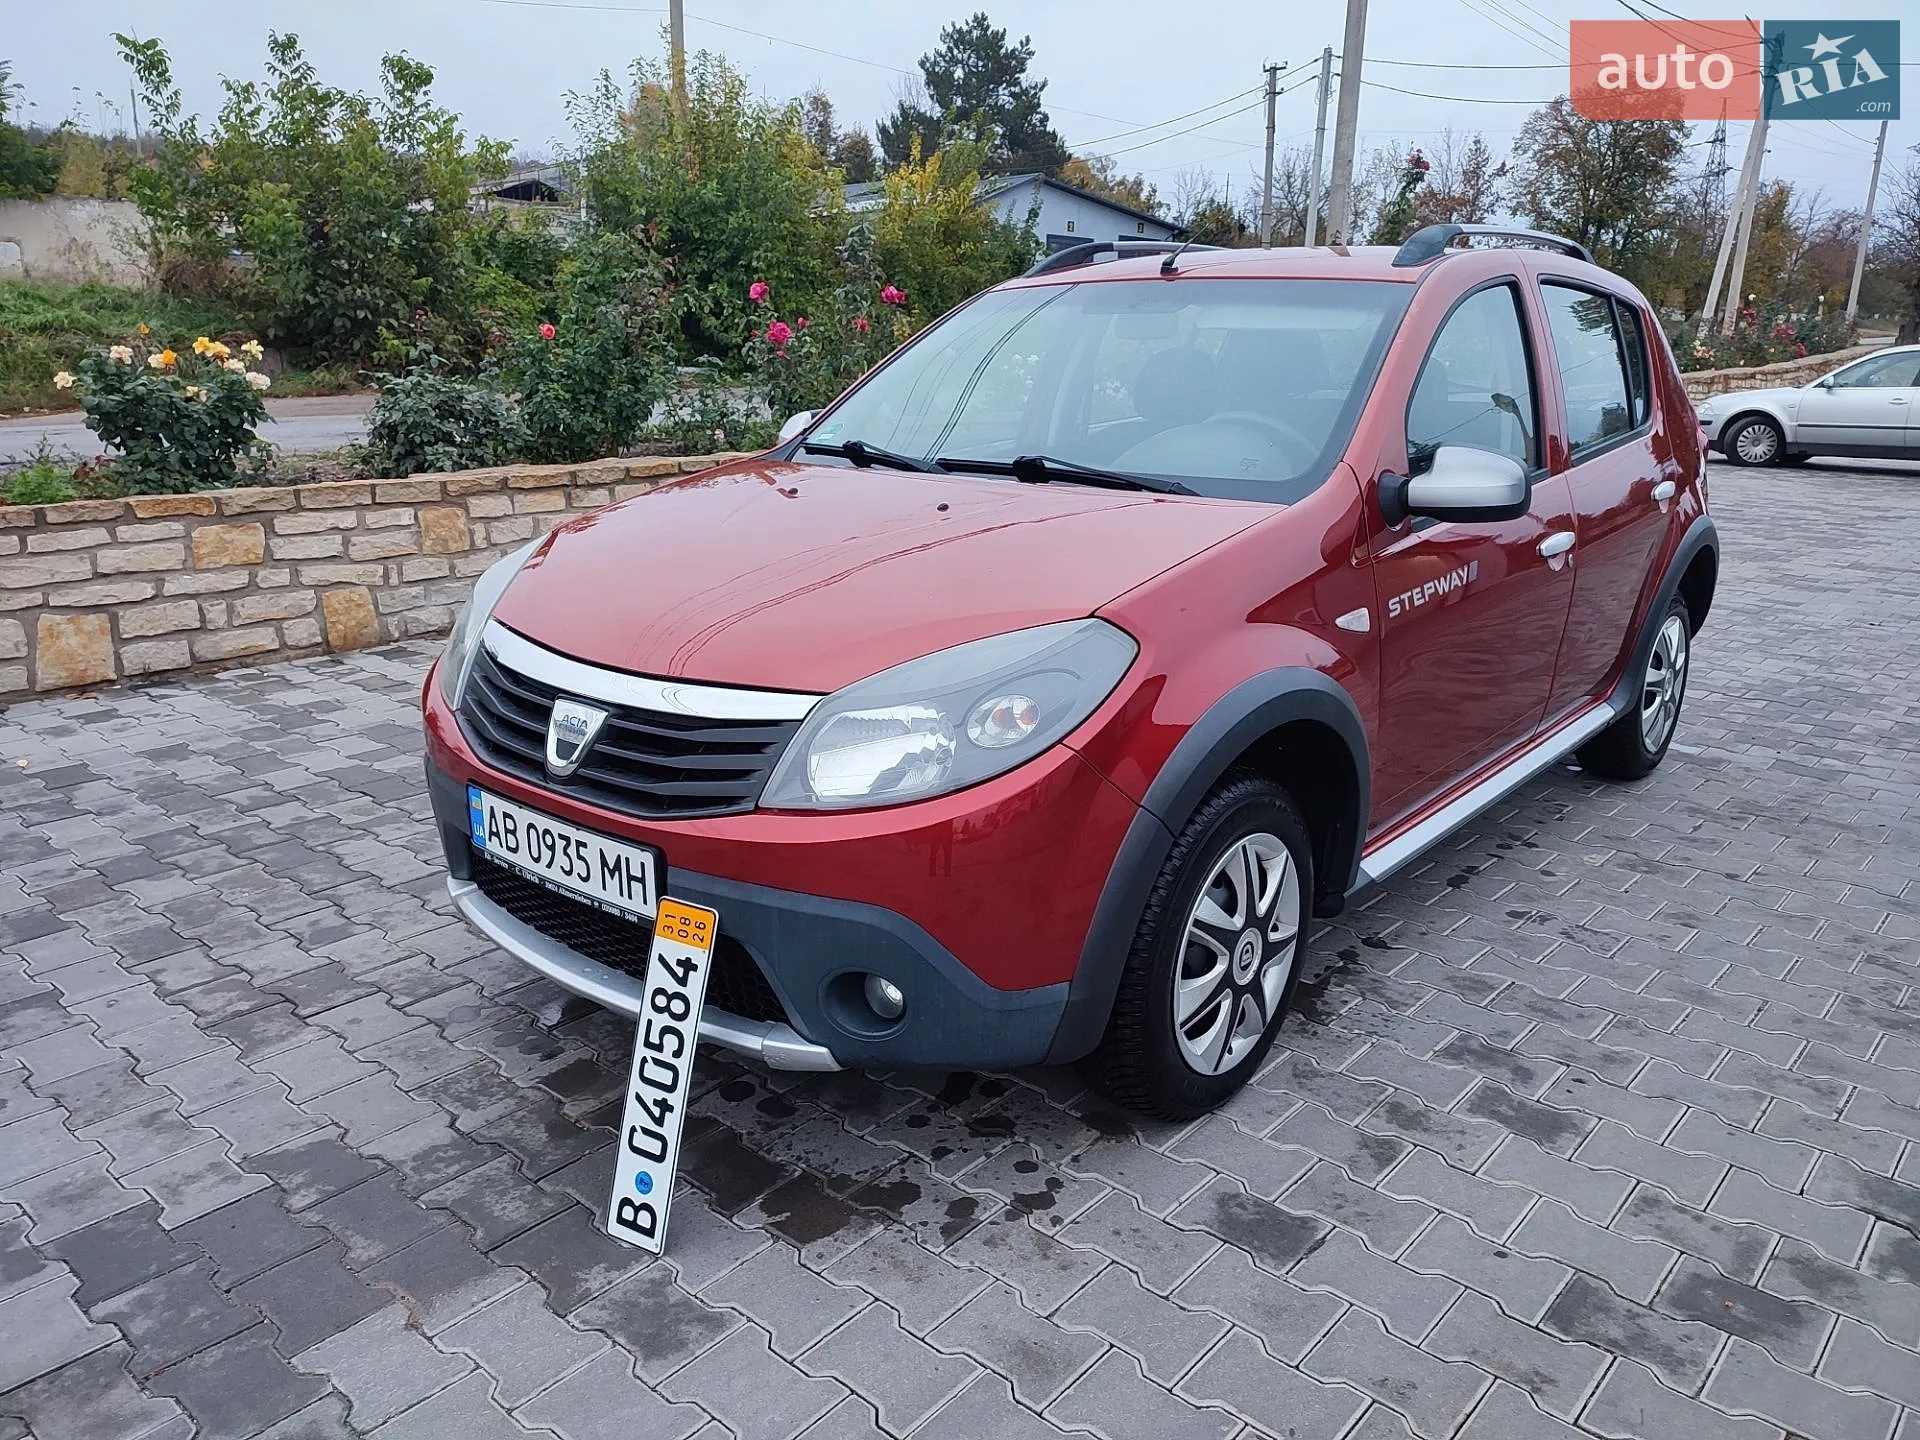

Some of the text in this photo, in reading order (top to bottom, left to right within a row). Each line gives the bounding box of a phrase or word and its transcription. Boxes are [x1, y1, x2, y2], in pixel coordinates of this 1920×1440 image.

[1388, 564, 1468, 618] STEPWAY
[473, 821, 485, 839] UA
[488, 805, 648, 906] AB 0935 MH
[662, 913, 677, 935] 31
[677, 916, 692, 939] 08
[692, 920, 707, 944] 26
[616, 952, 699, 1240] B 040584
